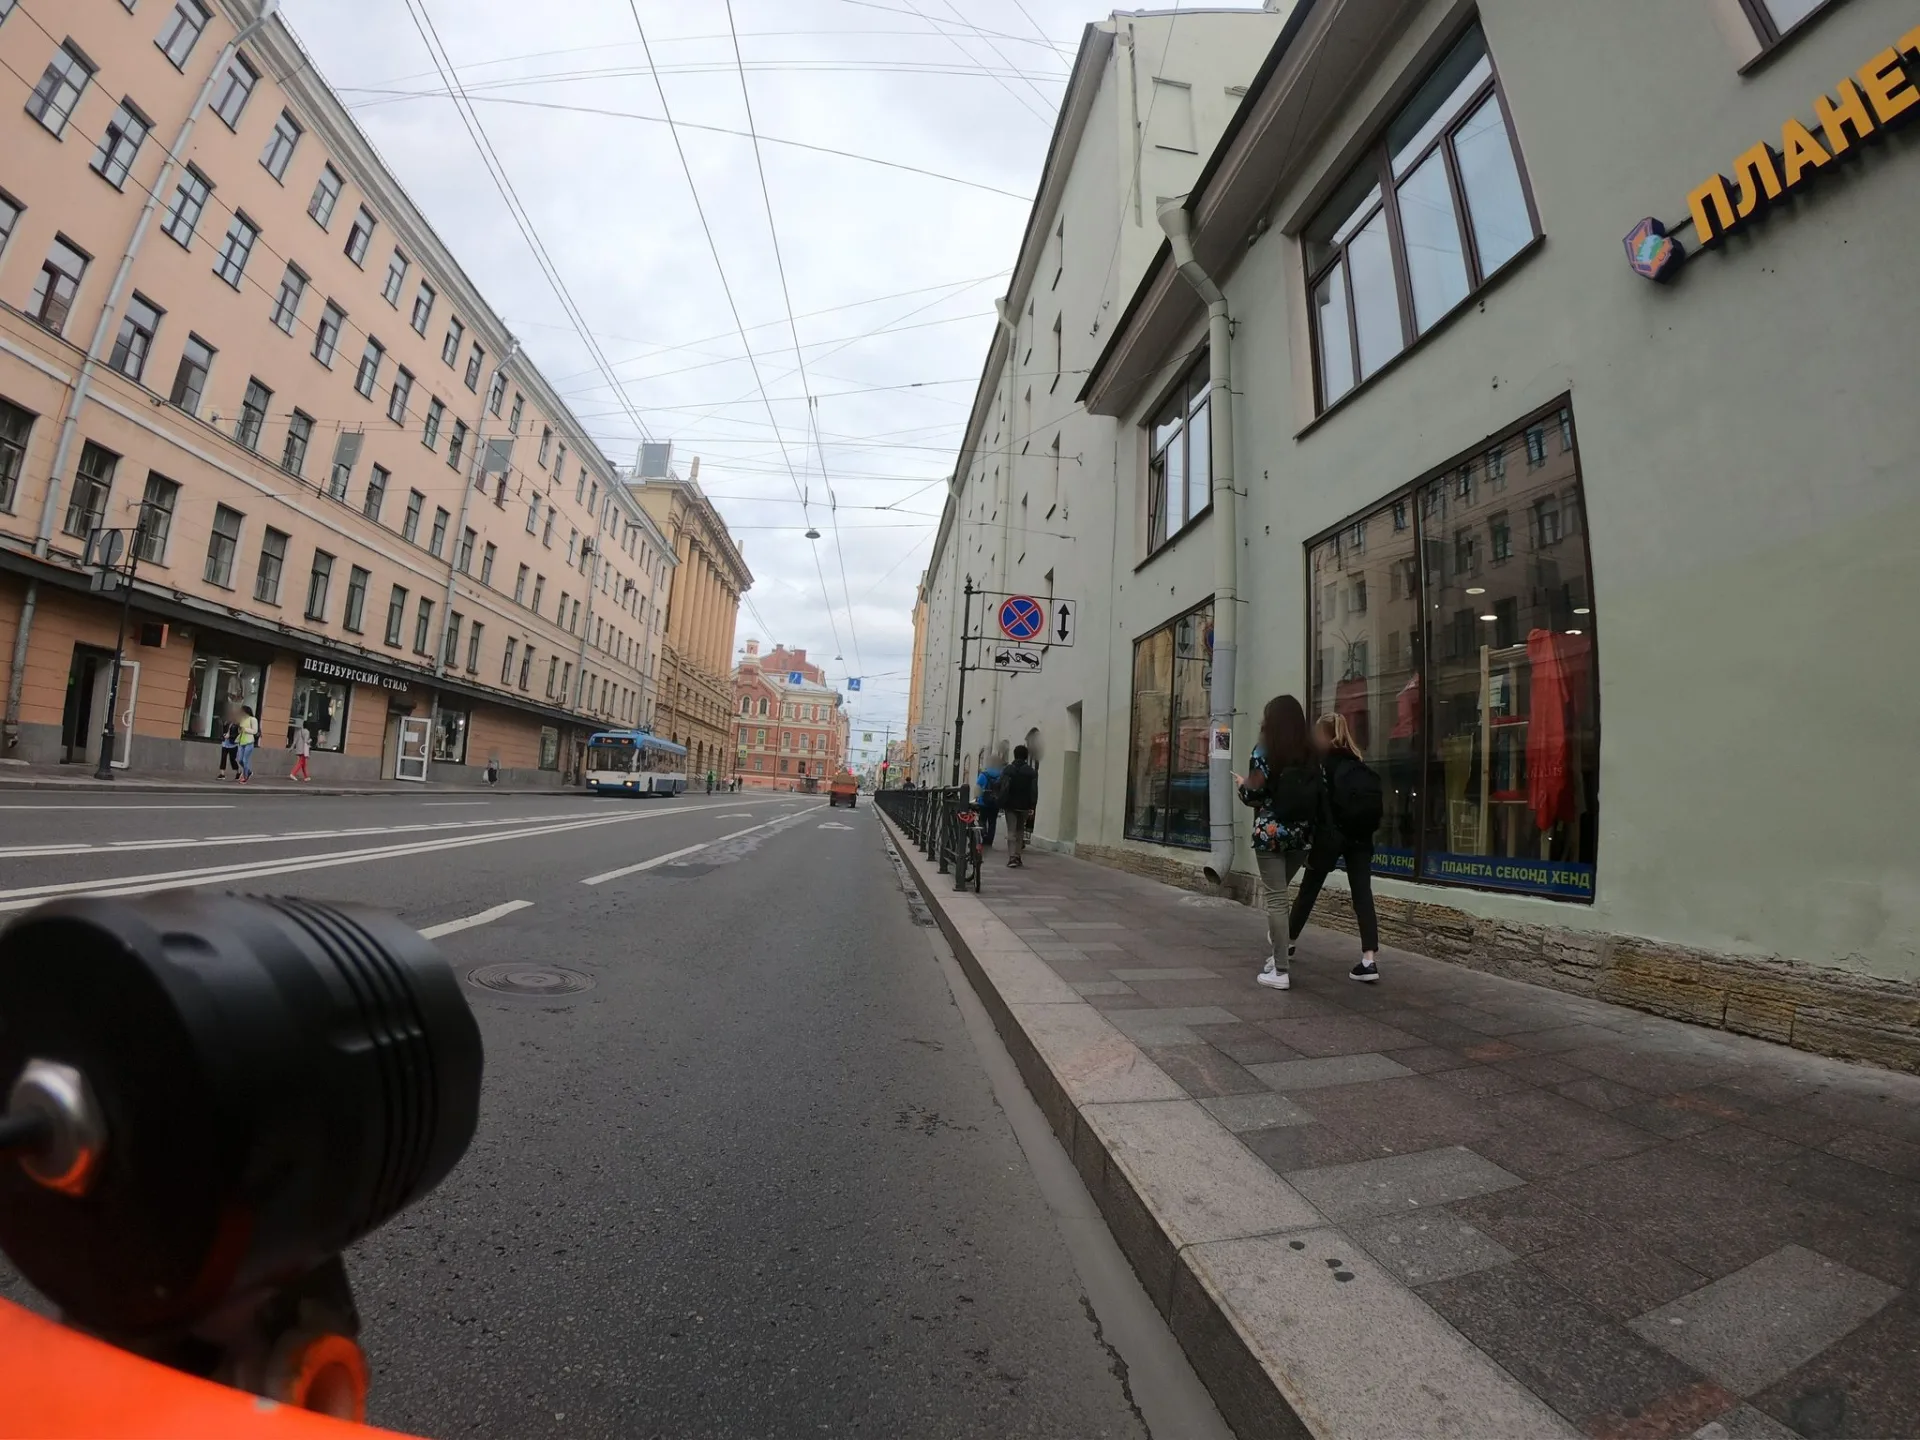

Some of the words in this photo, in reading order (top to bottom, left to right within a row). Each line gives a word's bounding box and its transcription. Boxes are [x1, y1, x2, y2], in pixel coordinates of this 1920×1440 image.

[304, 658, 380, 686] ПЕТЕРБУРГСКИЙ
[382, 678, 409, 692] СТИЛЬ
[1390, 855, 1415, 870] ХЕНД
[1441, 860, 1493, 877] ПЛАНЕТА
[1496, 866, 1548, 885] СЕКОНД
[1551, 870, 1590, 889] ХЕНД
